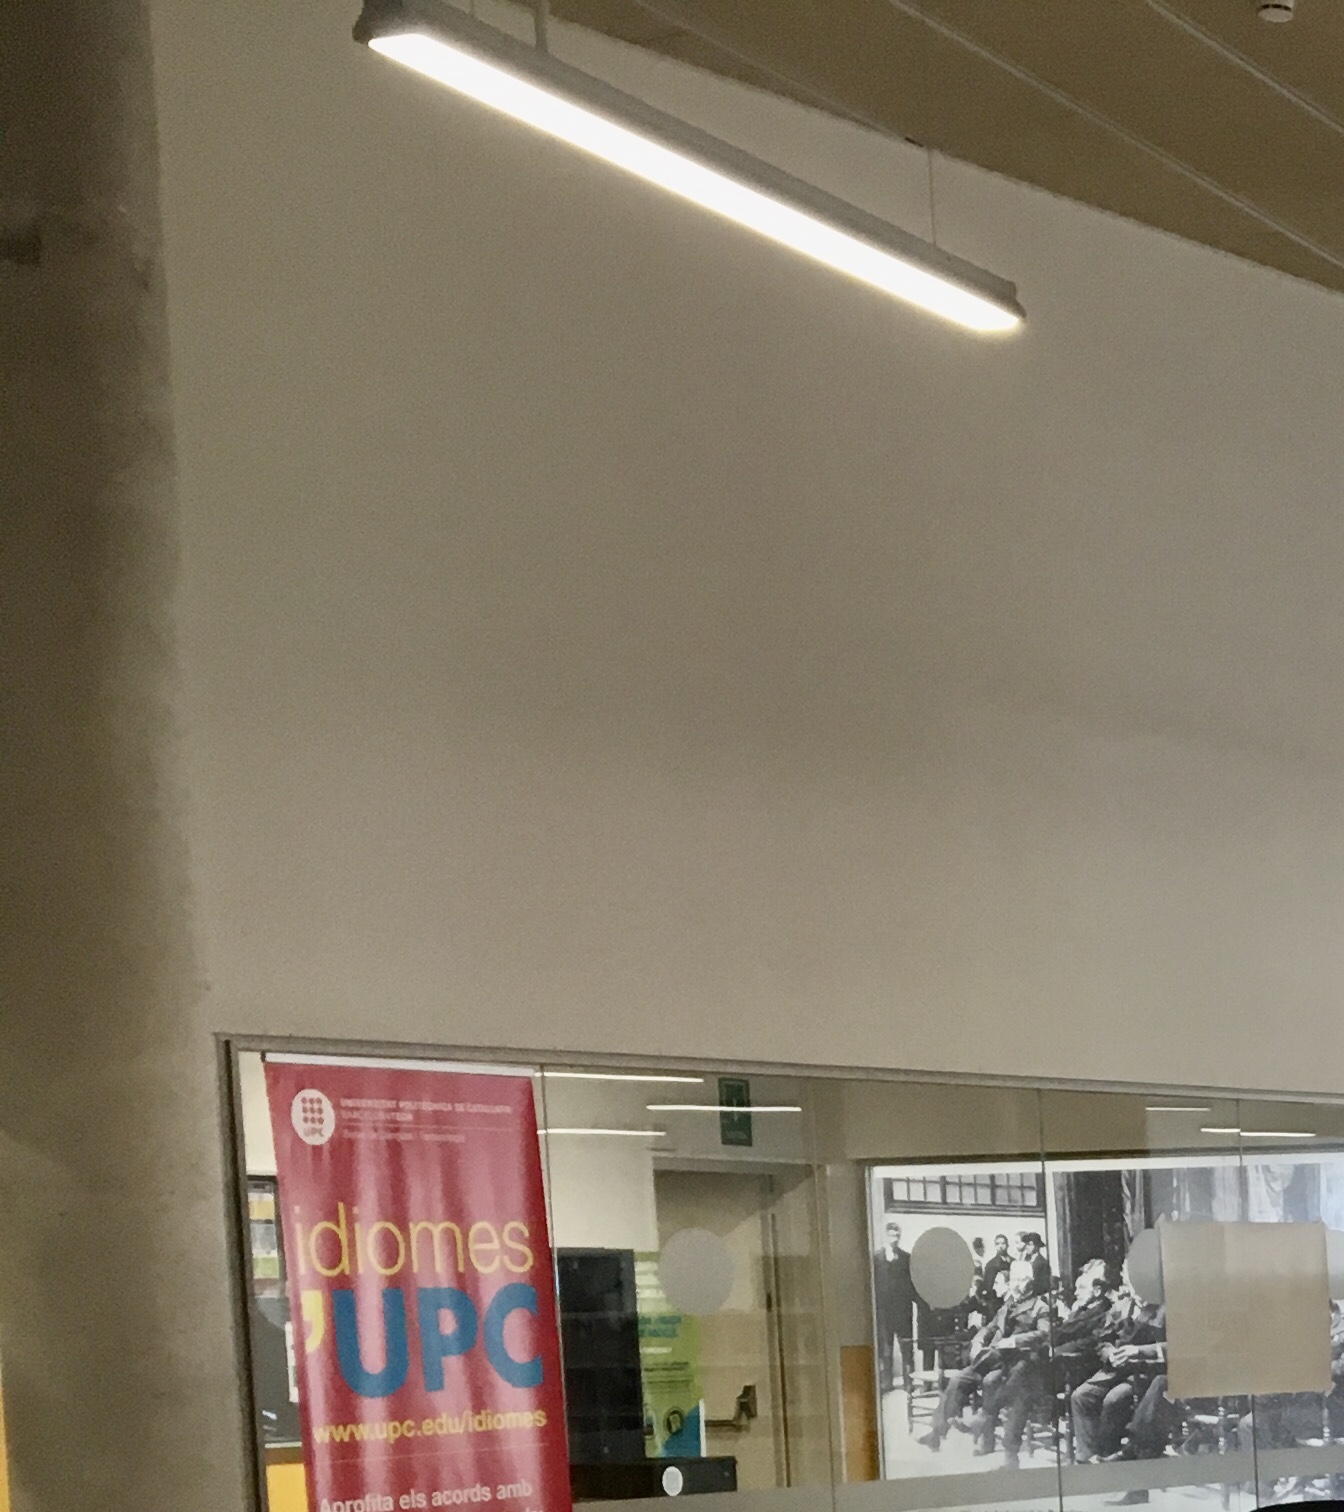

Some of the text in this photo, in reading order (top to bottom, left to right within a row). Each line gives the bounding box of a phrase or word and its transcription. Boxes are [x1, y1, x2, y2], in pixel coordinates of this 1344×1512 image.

[292, 1202, 534, 1278] idiomes
[312, 1408, 548, 1444] www.upc.edu/idiomes
[399, 1489, 426, 1510] els
[431, 1483, 492, 1506] acords
[496, 1482, 533, 1501] amb
